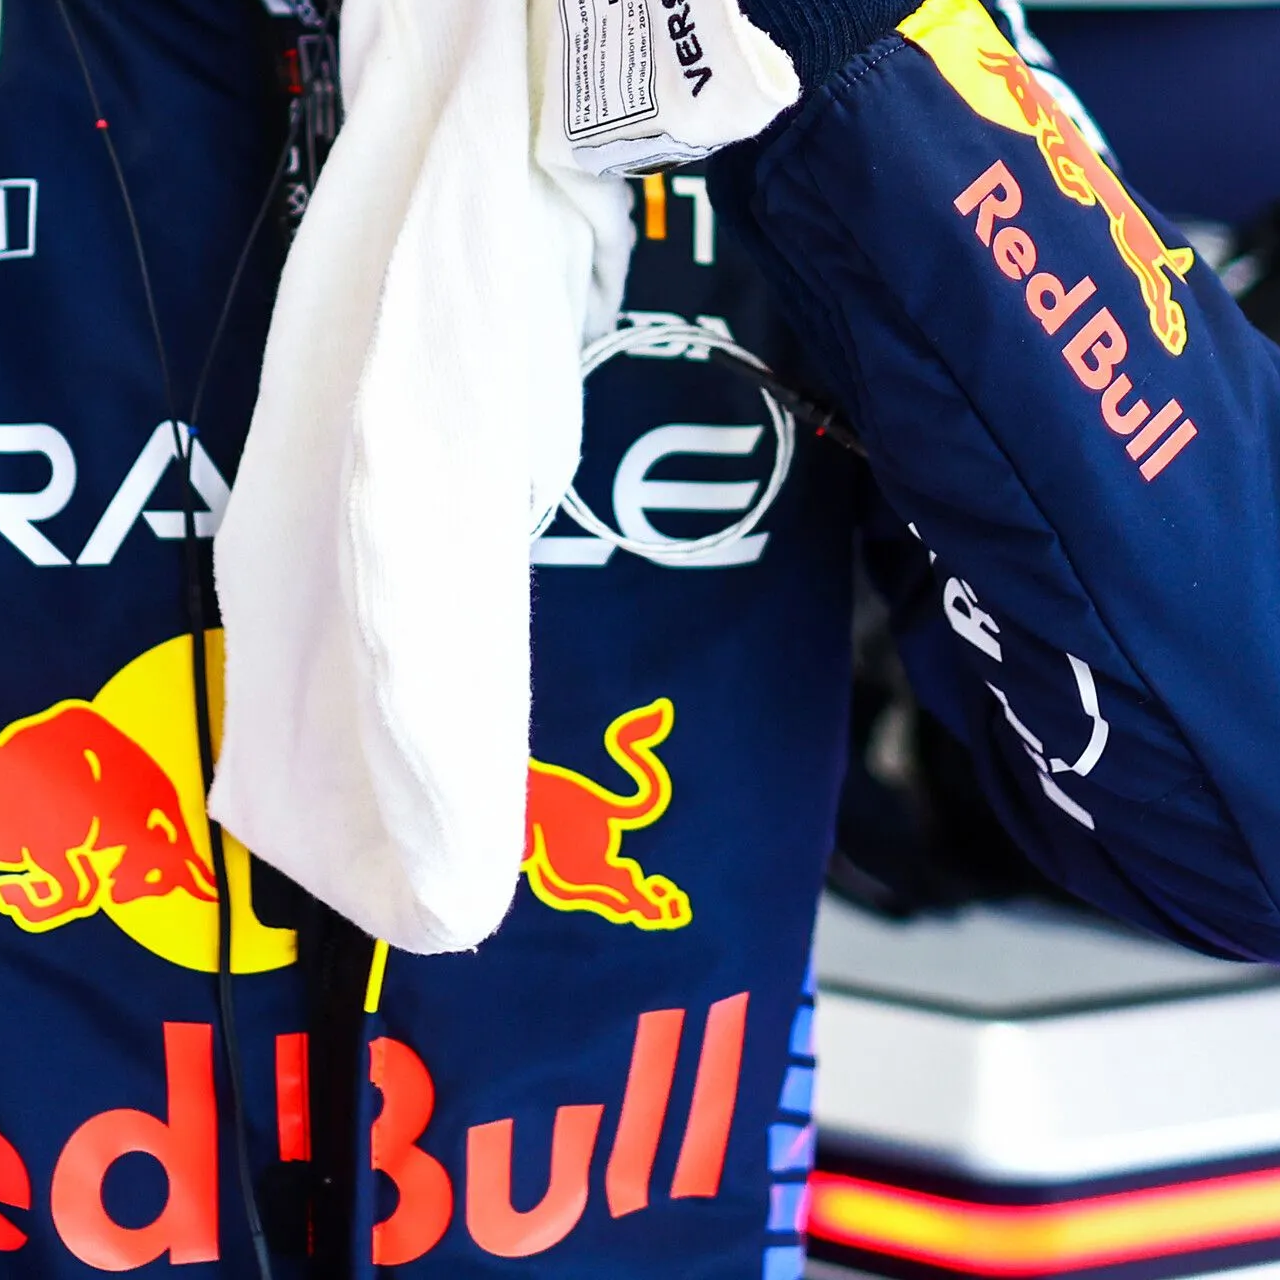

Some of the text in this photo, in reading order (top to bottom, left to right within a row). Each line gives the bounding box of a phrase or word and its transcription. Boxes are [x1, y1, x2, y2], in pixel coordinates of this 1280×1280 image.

[638, 3, 646, 29] 2034
[574, 56, 582, 112] compliance
[582, 53, 590, 101] Standard
[598, 50, 608, 116] Manufacturer
[626, 38, 636, 108] Homologation
[638, 60, 647, 83] valid
[638, 86, 646, 105] Not
[953, 160, 1198, 482] Red Bull
[275, 991, 749, 1266] Bull
